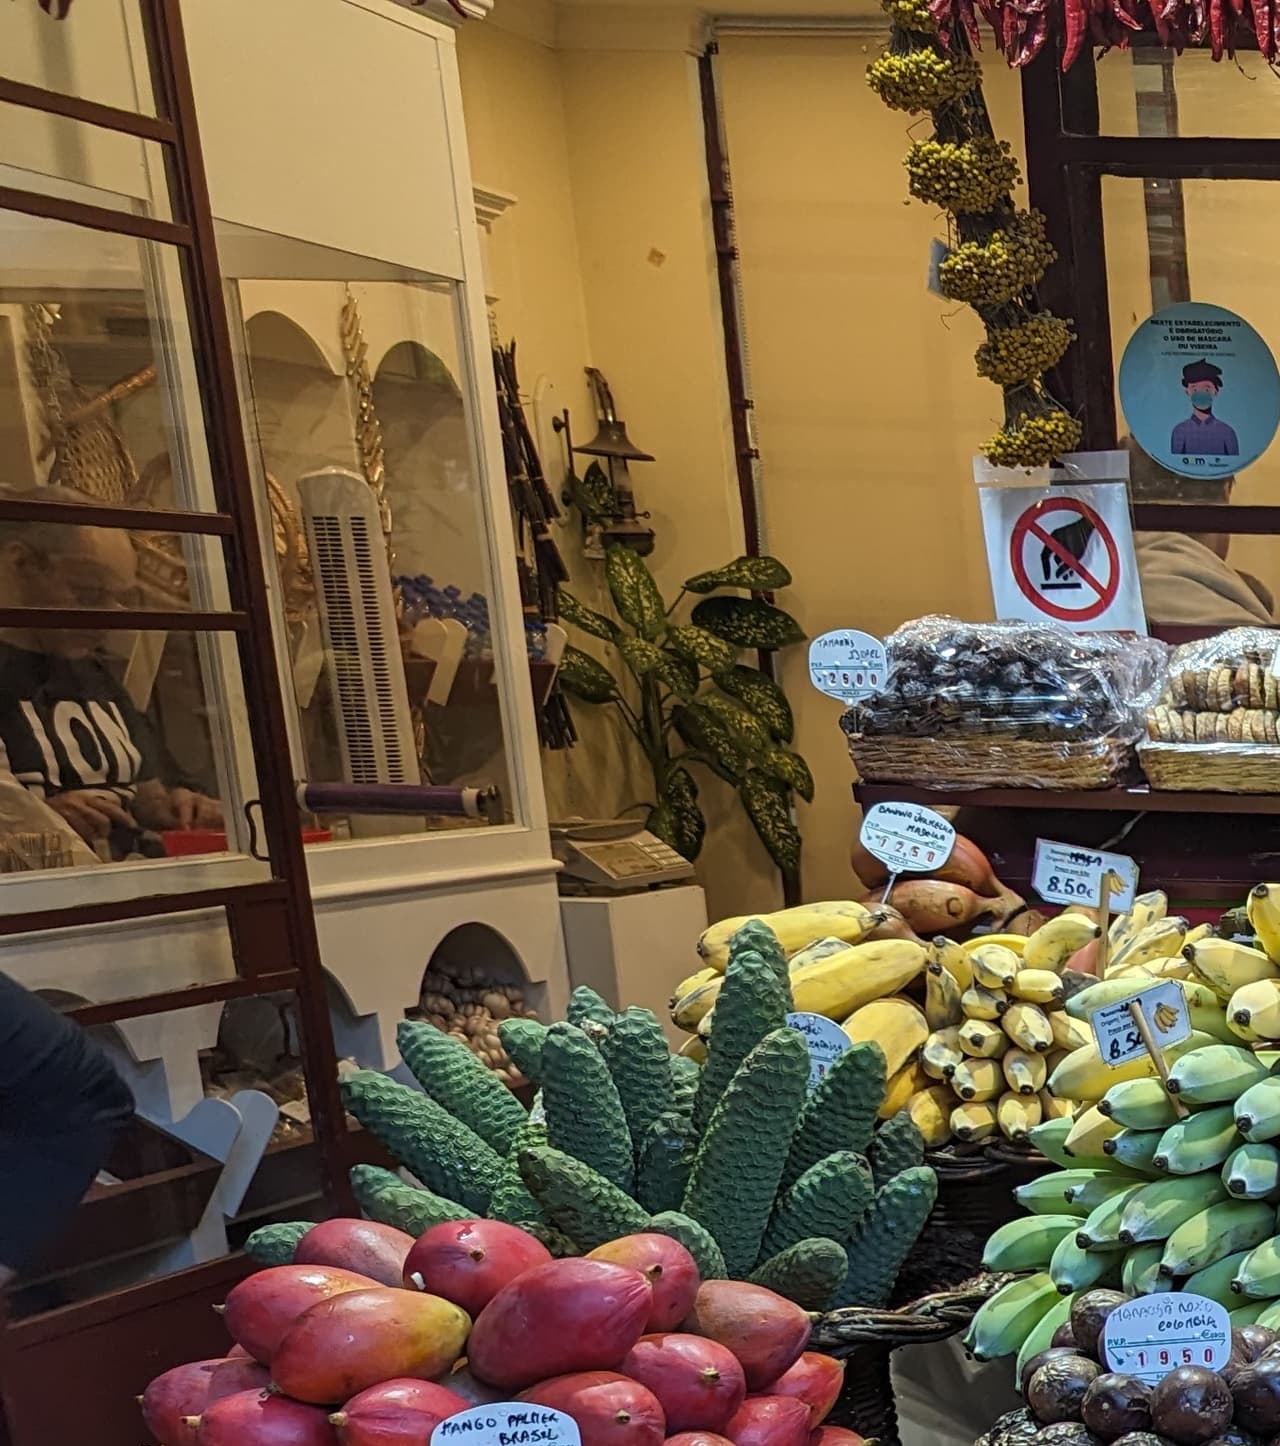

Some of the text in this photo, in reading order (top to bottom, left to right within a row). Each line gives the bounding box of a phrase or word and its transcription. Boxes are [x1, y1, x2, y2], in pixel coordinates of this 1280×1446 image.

[1174, 319, 1241, 327] ESTABELECIMENTO
[1175, 326, 1224, 335] OBRIGATÓRIO
[1197, 334, 1232, 343] MÁSCARA
[1138, 1348, 1213, 1367] 19,50
